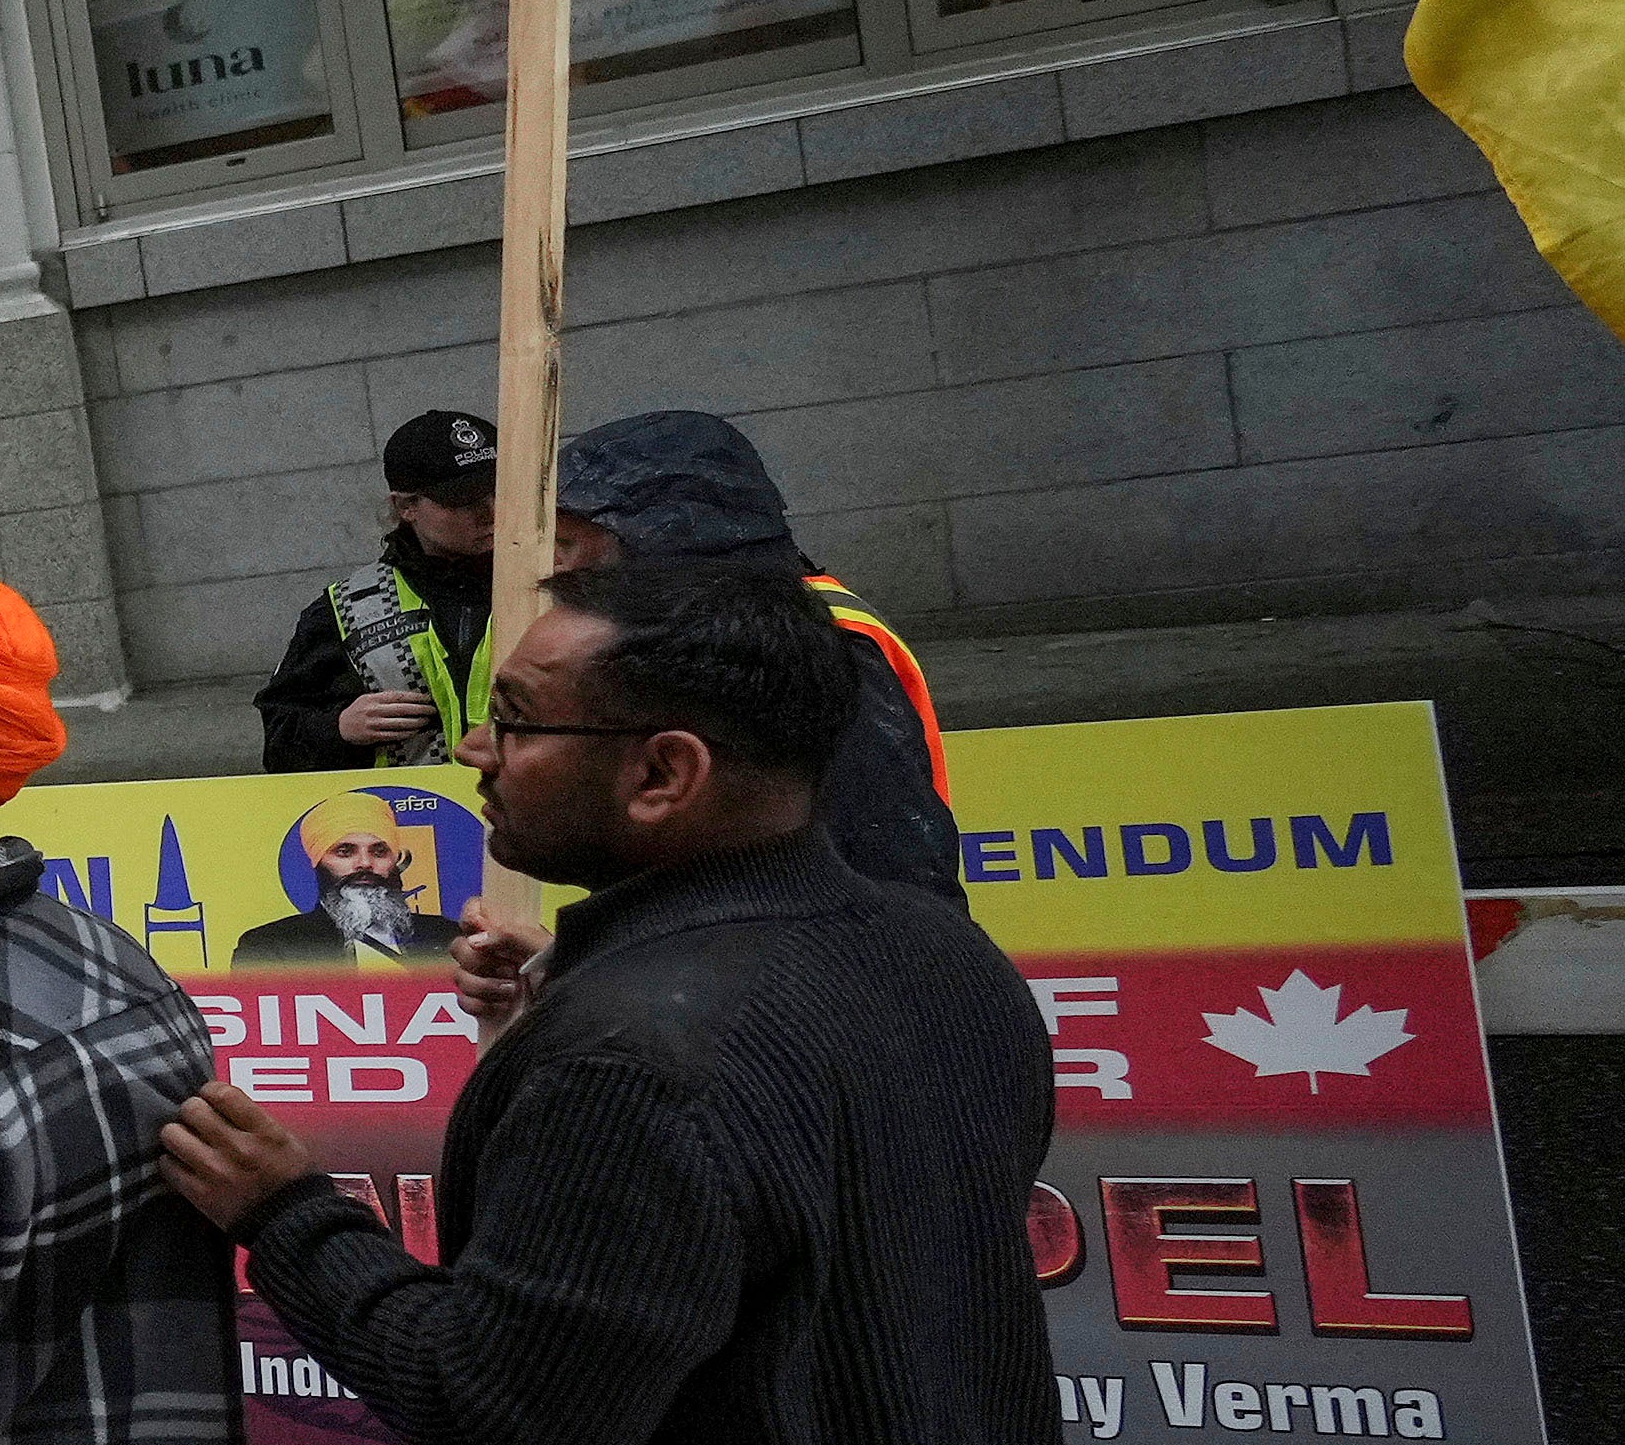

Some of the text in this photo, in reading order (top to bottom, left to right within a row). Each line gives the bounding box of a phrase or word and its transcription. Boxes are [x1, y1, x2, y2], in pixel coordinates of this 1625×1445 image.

[128, 45, 265, 98] luna
[360, 616, 407, 639] PUBLIC
[395, 620, 428, 640] UNIT
[1150, 1360, 1447, 1441] Verma
